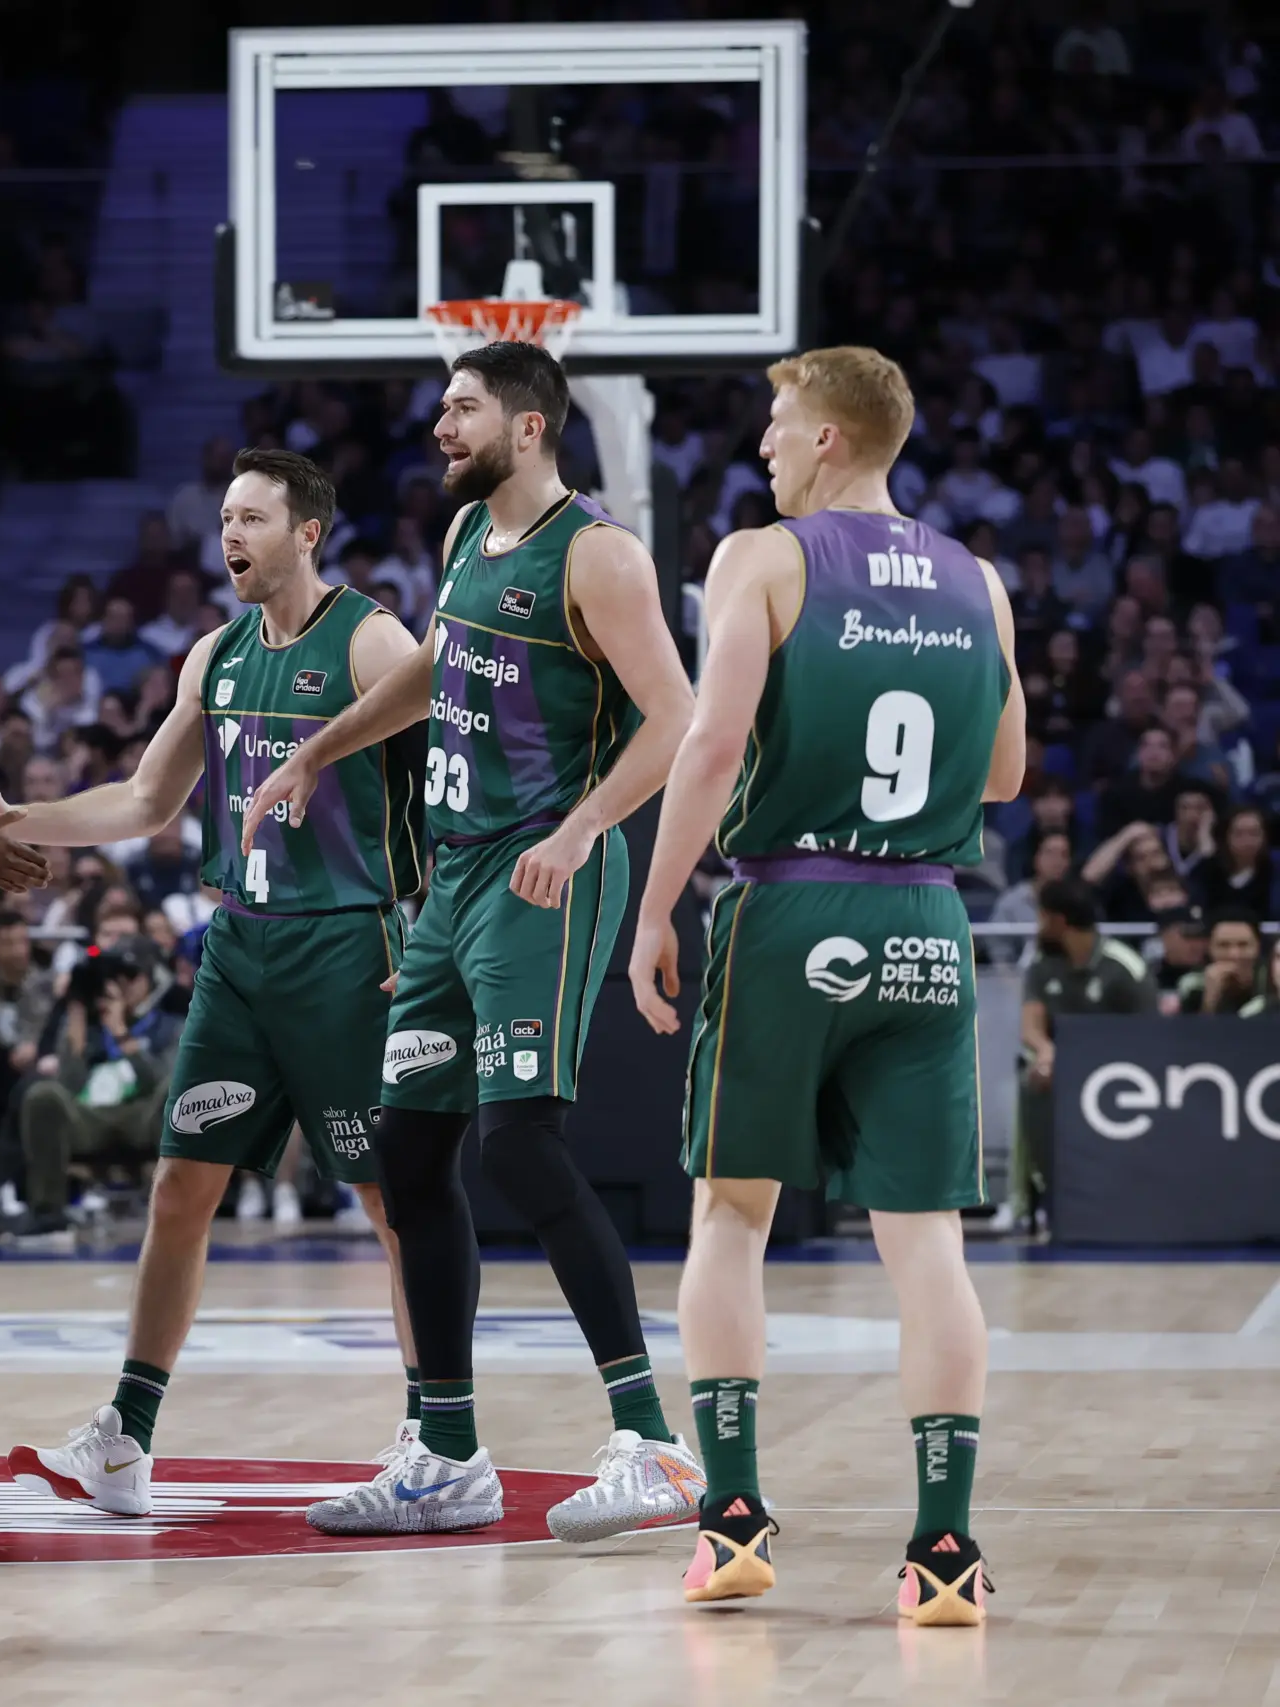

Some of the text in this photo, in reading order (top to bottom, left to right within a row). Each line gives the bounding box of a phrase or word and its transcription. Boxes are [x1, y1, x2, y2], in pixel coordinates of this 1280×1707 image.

[867, 545, 937, 590] DÍAZ
[447, 641, 520, 687] Unicaja
[861, 690, 935, 822] 9
[424, 747, 469, 812] 33
[245, 849, 270, 903] 4
[883, 936, 960, 963] COSTA
[881, 963, 960, 985] DEL SOL
[878, 982, 958, 1007] MÁLAGA
[514, 1026, 535, 1035] acb
[174, 1085, 253, 1124] famadesa
[323, 1106, 346, 1118] sabor
[331, 1112, 367, 1135] má
[330, 1132, 370, 1159] laga
